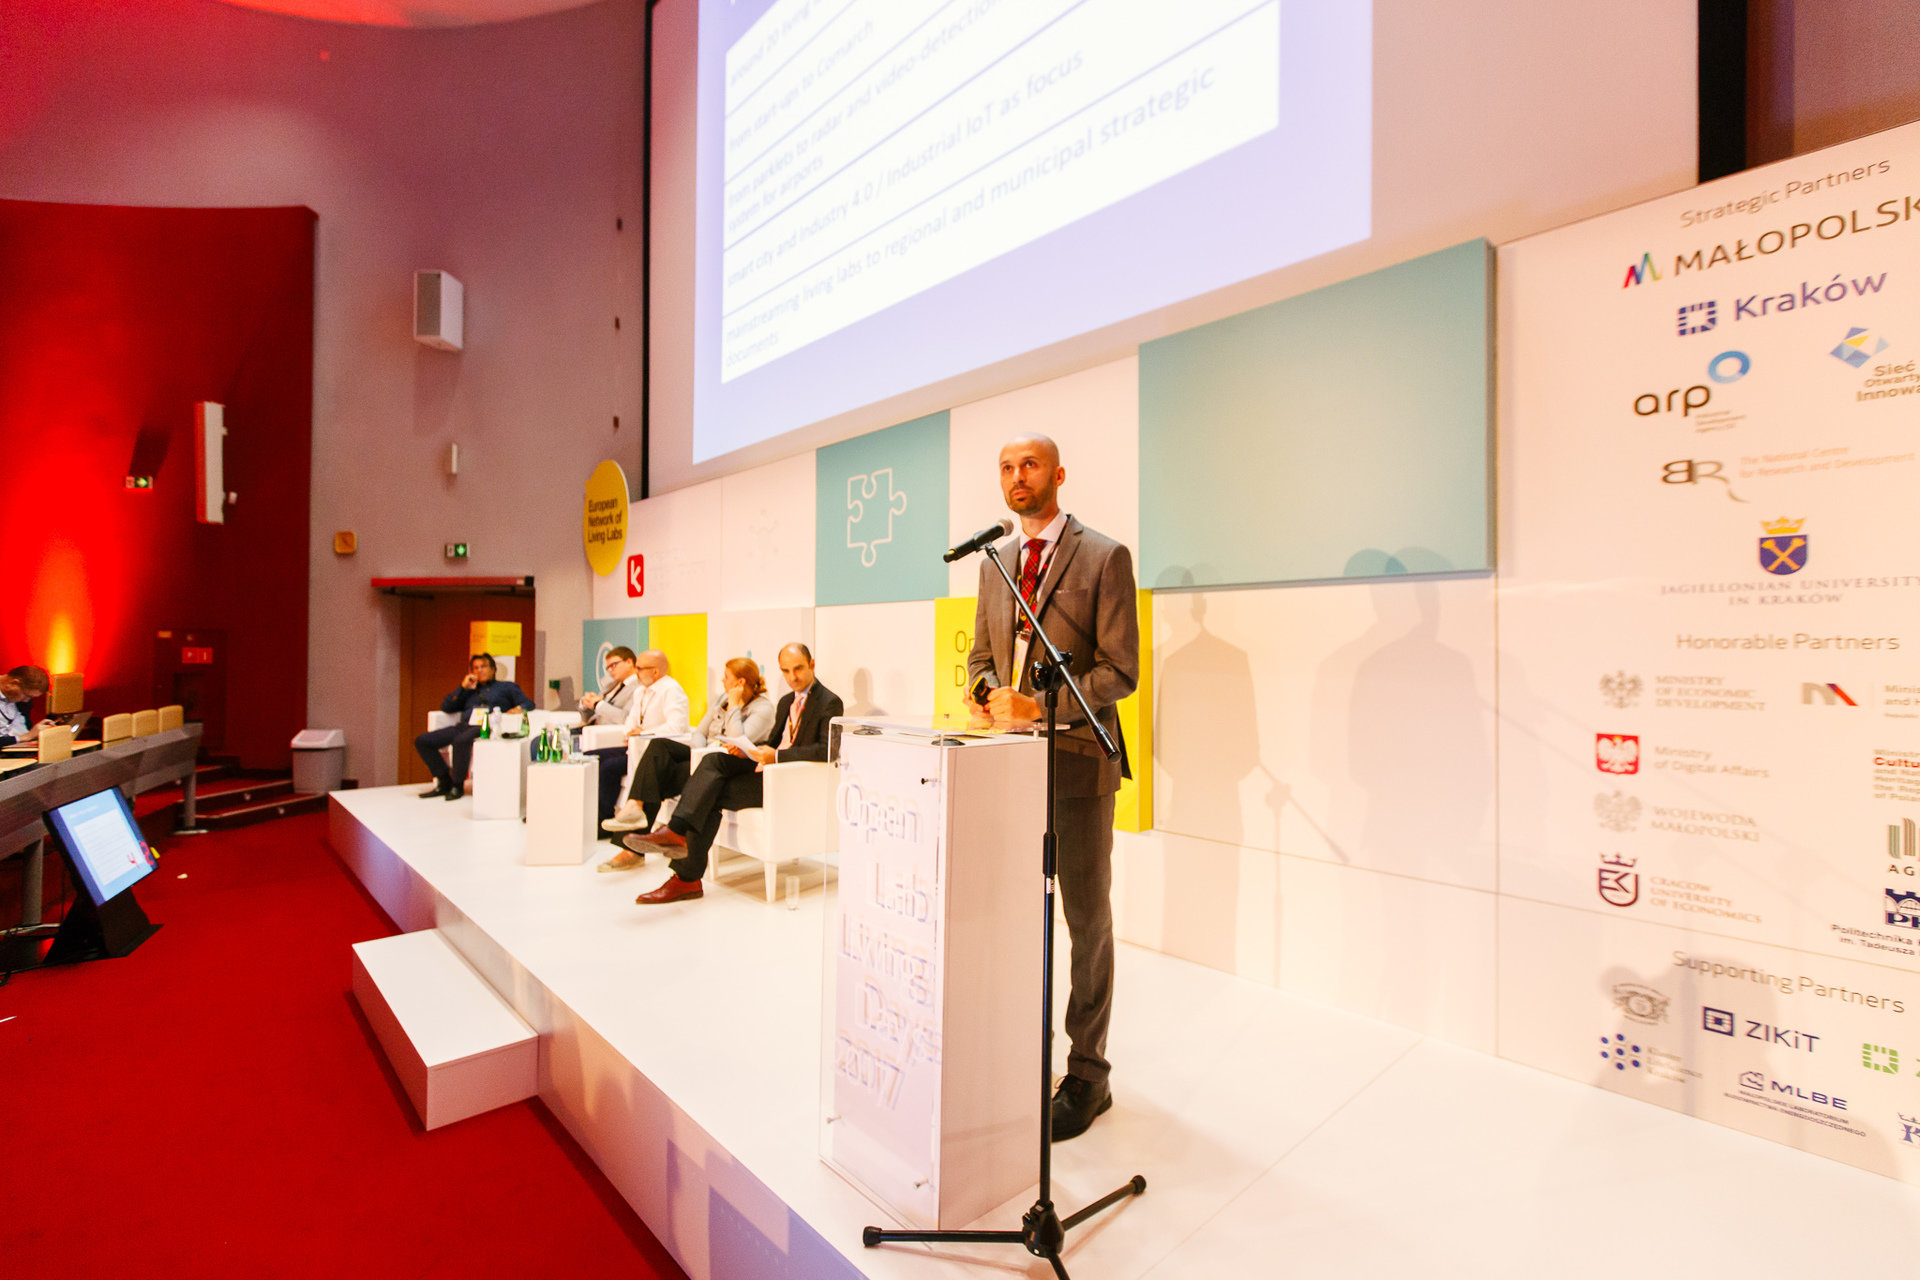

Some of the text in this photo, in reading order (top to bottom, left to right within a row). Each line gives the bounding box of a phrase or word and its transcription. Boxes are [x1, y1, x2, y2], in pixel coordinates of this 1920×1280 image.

[777, 230, 797, 256] and
[852, 182, 873, 206] 4.0
[1000, 89, 1020, 117] as
[1025, 48, 1084, 100] focus
[726, 65, 1216, 342] mainstreaming living labs to regional and municipal strategic
[1679, 159, 1891, 229] Strategic Partners
[1734, 272, 1888, 322] Kraków
[1633, 384, 1712, 418] arp
[588, 497, 618, 513] European
[588, 509, 623, 527] Network of
[588, 527, 623, 545] Living Labs
[1661, 580, 1792, 596] JAGIELLONIAN
[1728, 595, 1750, 608] IN
[1676, 632, 1900, 650] Honorable Partners
[1655, 675, 1725, 687] MINISTRY
[1655, 686, 1673, 698] OF
[1655, 698, 1766, 712] DEVELOPMENT
[837, 777, 921, 844] Open
[1672, 949, 1906, 1014] Supporting Partners
[1745, 1019, 1820, 1053] ZIKiT
[1770, 1080, 1849, 1111] MLBE
